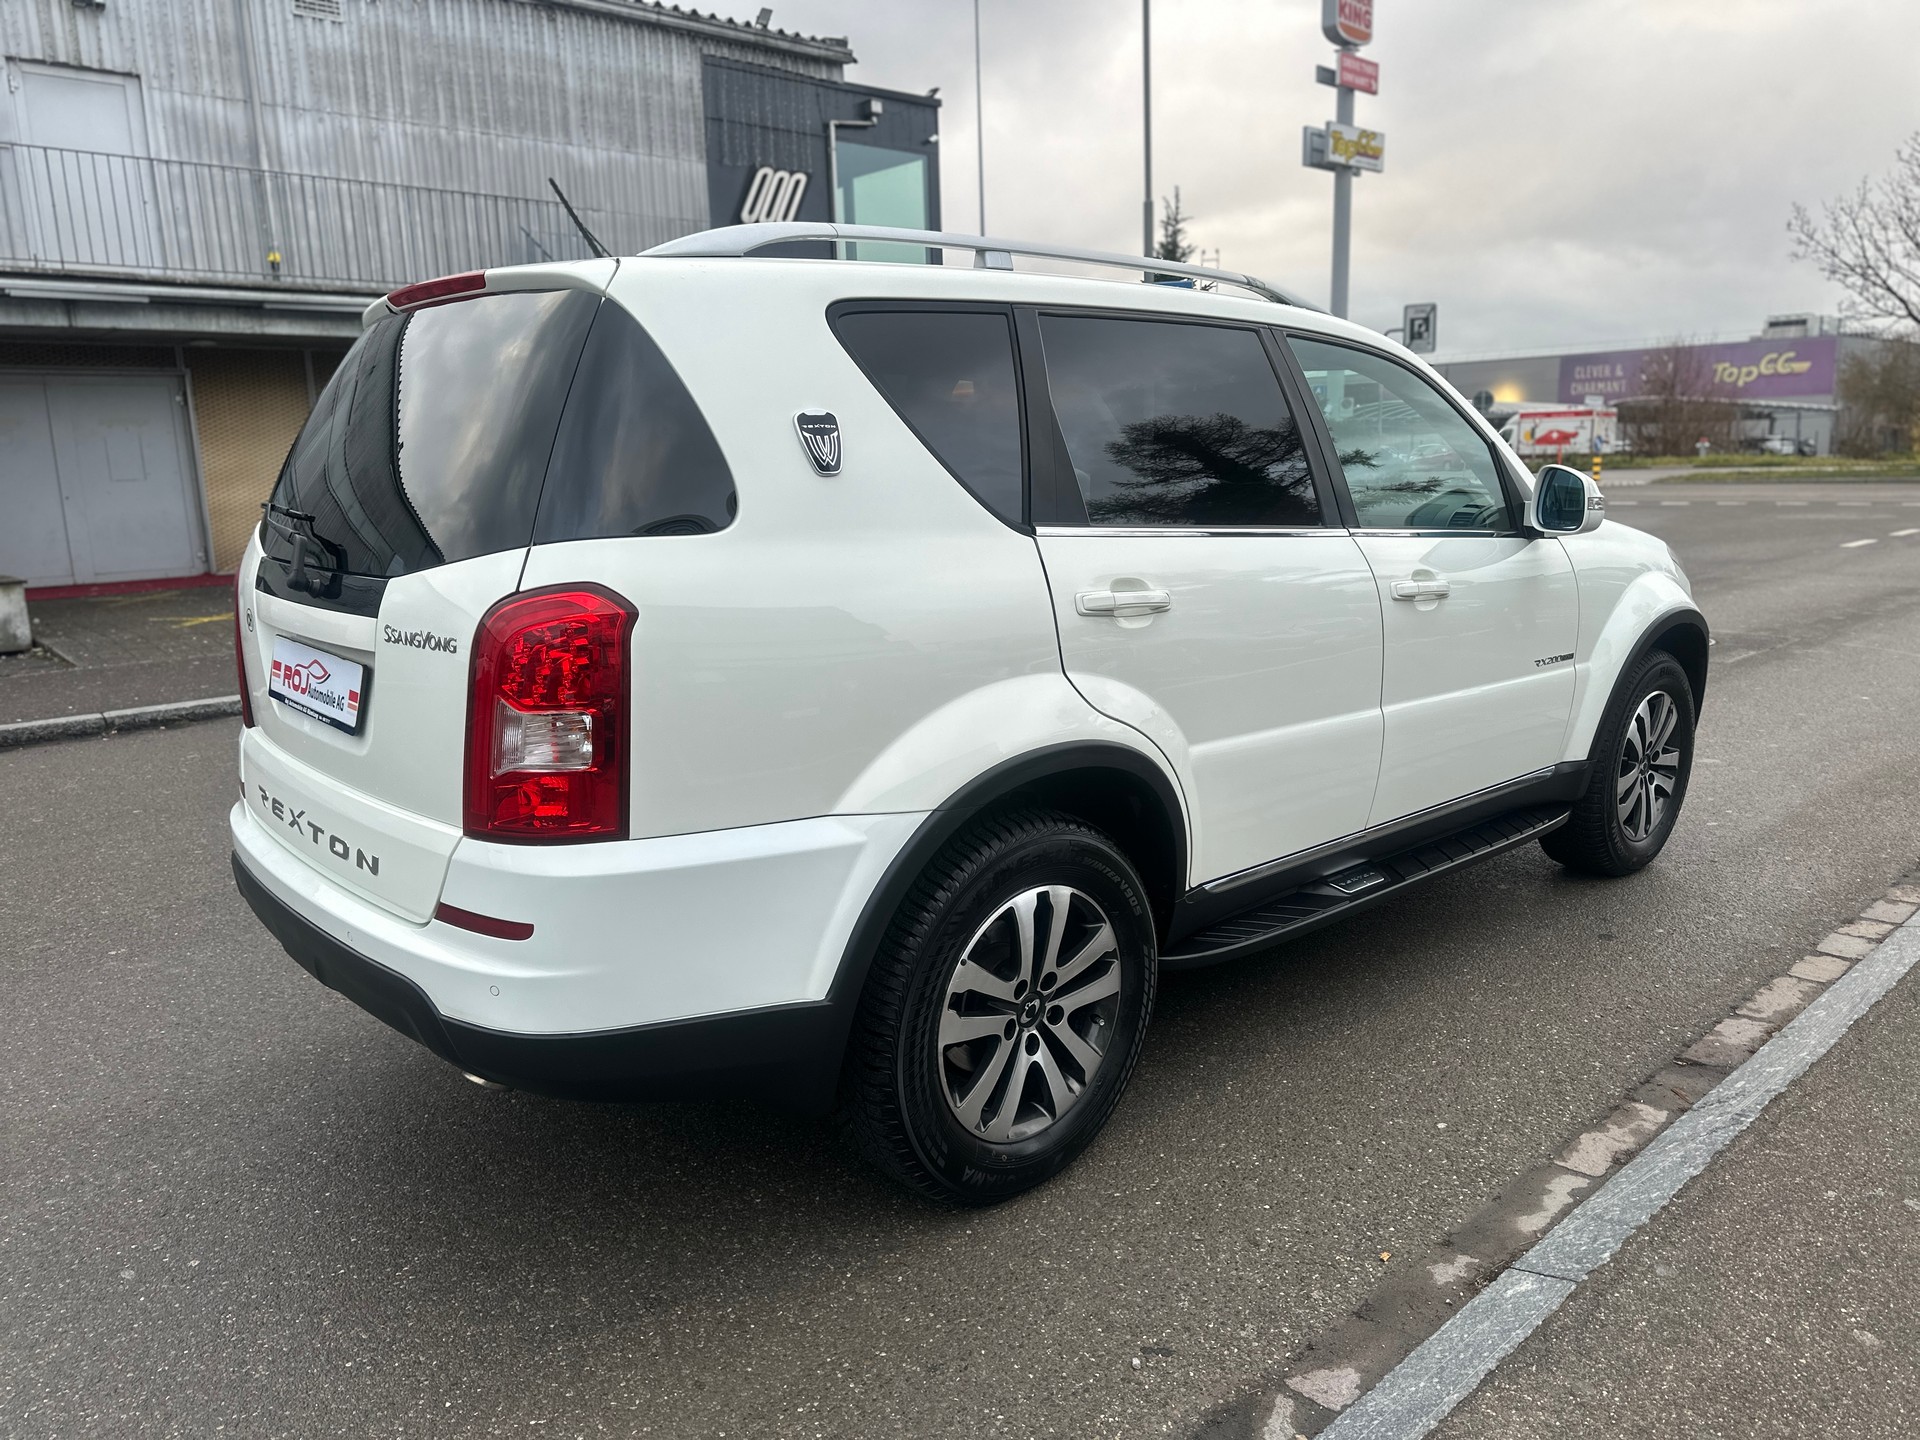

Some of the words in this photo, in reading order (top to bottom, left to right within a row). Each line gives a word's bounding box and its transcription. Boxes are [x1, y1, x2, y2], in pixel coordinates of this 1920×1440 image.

[1339, 0, 1372, 29] KING
[1574, 363, 1611, 379] CLEVER
[1713, 351, 1797, 387] TopCC
[1570, 380, 1626, 396] CHARMANT
[307, 683, 336, 708] Automobile
[336, 695, 345, 711] AG
[258, 784, 380, 876] REXTON
